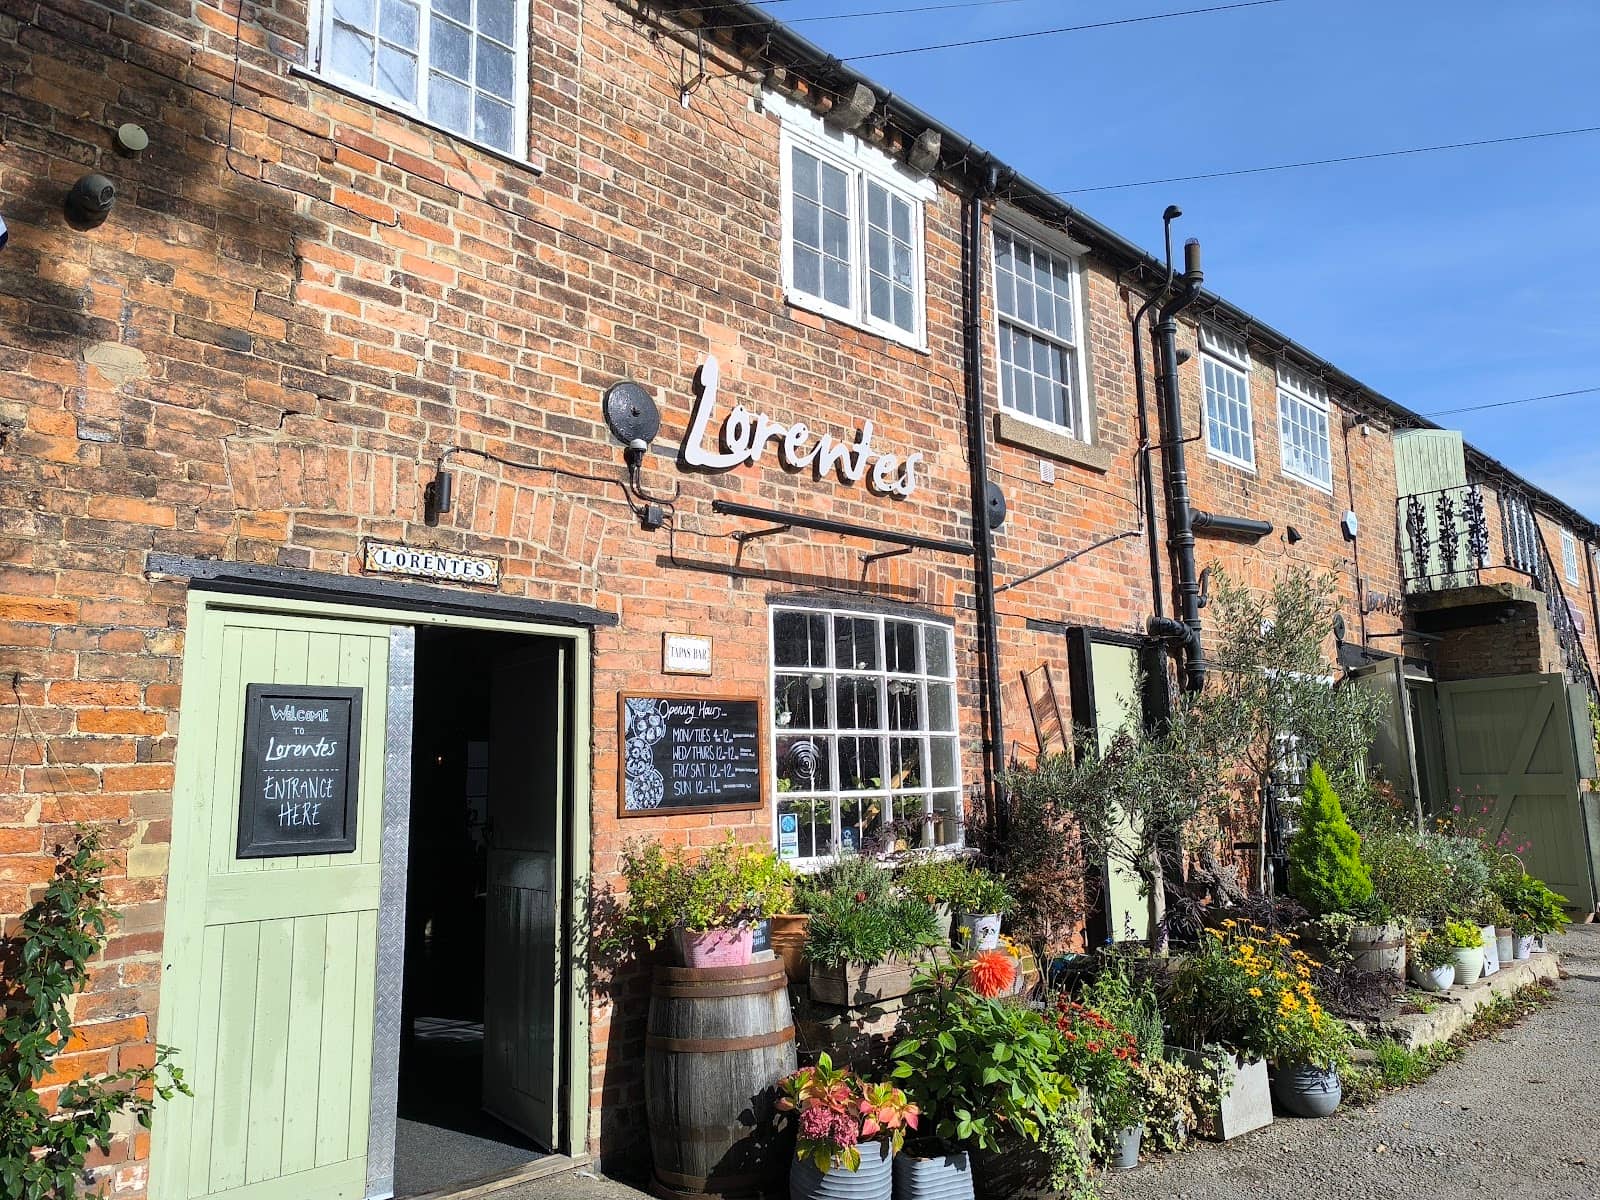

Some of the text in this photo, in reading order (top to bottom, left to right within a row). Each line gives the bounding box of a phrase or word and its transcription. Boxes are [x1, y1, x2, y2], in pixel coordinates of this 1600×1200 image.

[684, 354, 925, 495] Lorentes
[381, 550, 485, 577] LORENTES
[671, 646, 707, 660] TAPAS BAR
[659, 700, 699, 724] Opening
[292, 727, 305, 735] TO
[672, 728, 711, 743] MON/TUES
[265, 737, 338, 761] Lorentes
[672, 745, 715, 760] WED/THURS
[263, 776, 334, 800] ENTRANCE
[673, 781, 692, 796] SUN
[278, 802, 322, 826] HERE
